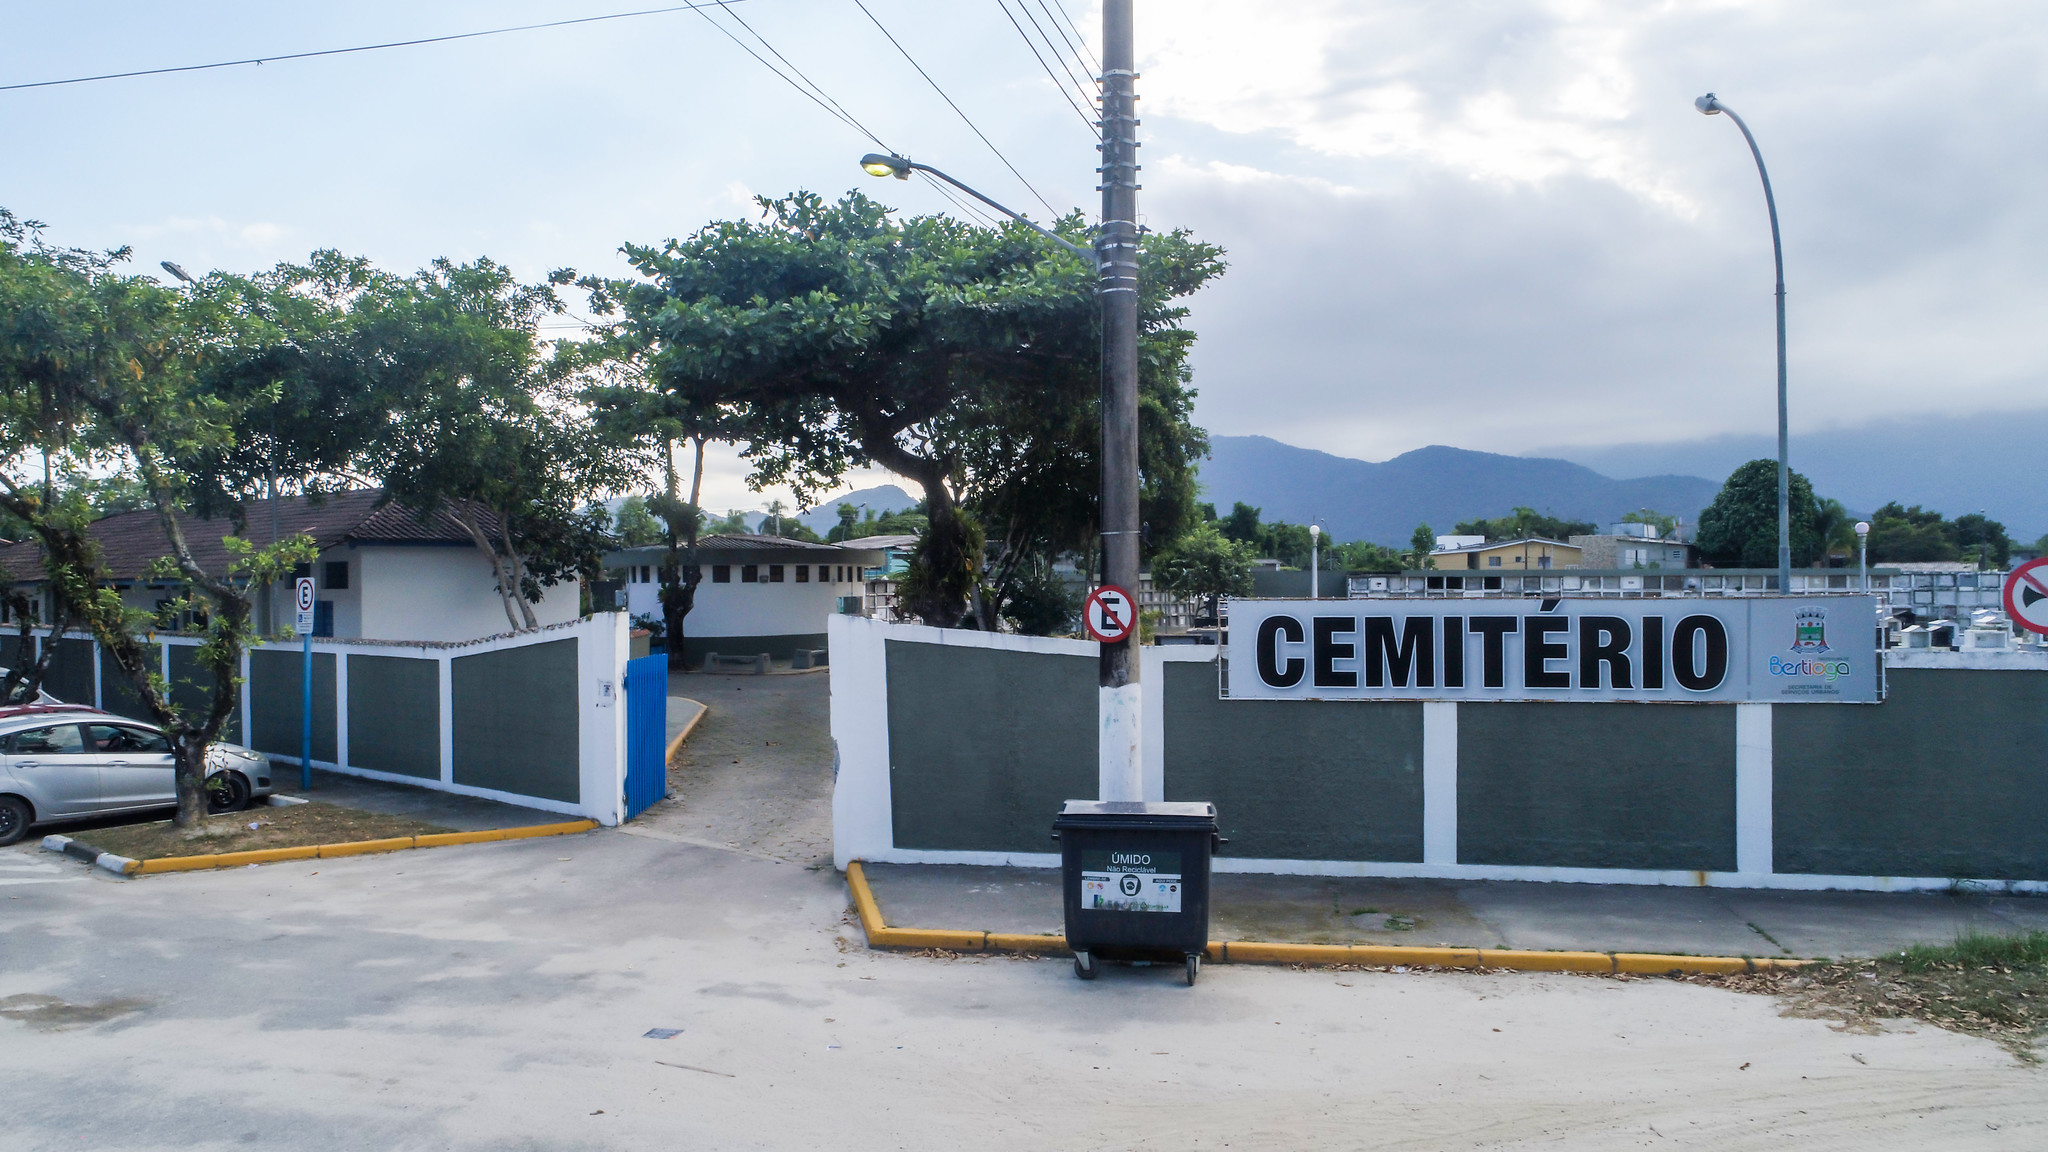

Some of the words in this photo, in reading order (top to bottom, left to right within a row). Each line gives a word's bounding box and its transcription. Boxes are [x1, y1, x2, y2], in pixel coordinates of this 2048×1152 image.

[1101, 597, 1120, 630] E
[1256, 600, 1730, 692] CEMITÉRIO
[1769, 656, 1850, 681] Bertioga
[1106, 865, 1121, 873] Não
[1111, 851, 1151, 865] ÚMIDO
